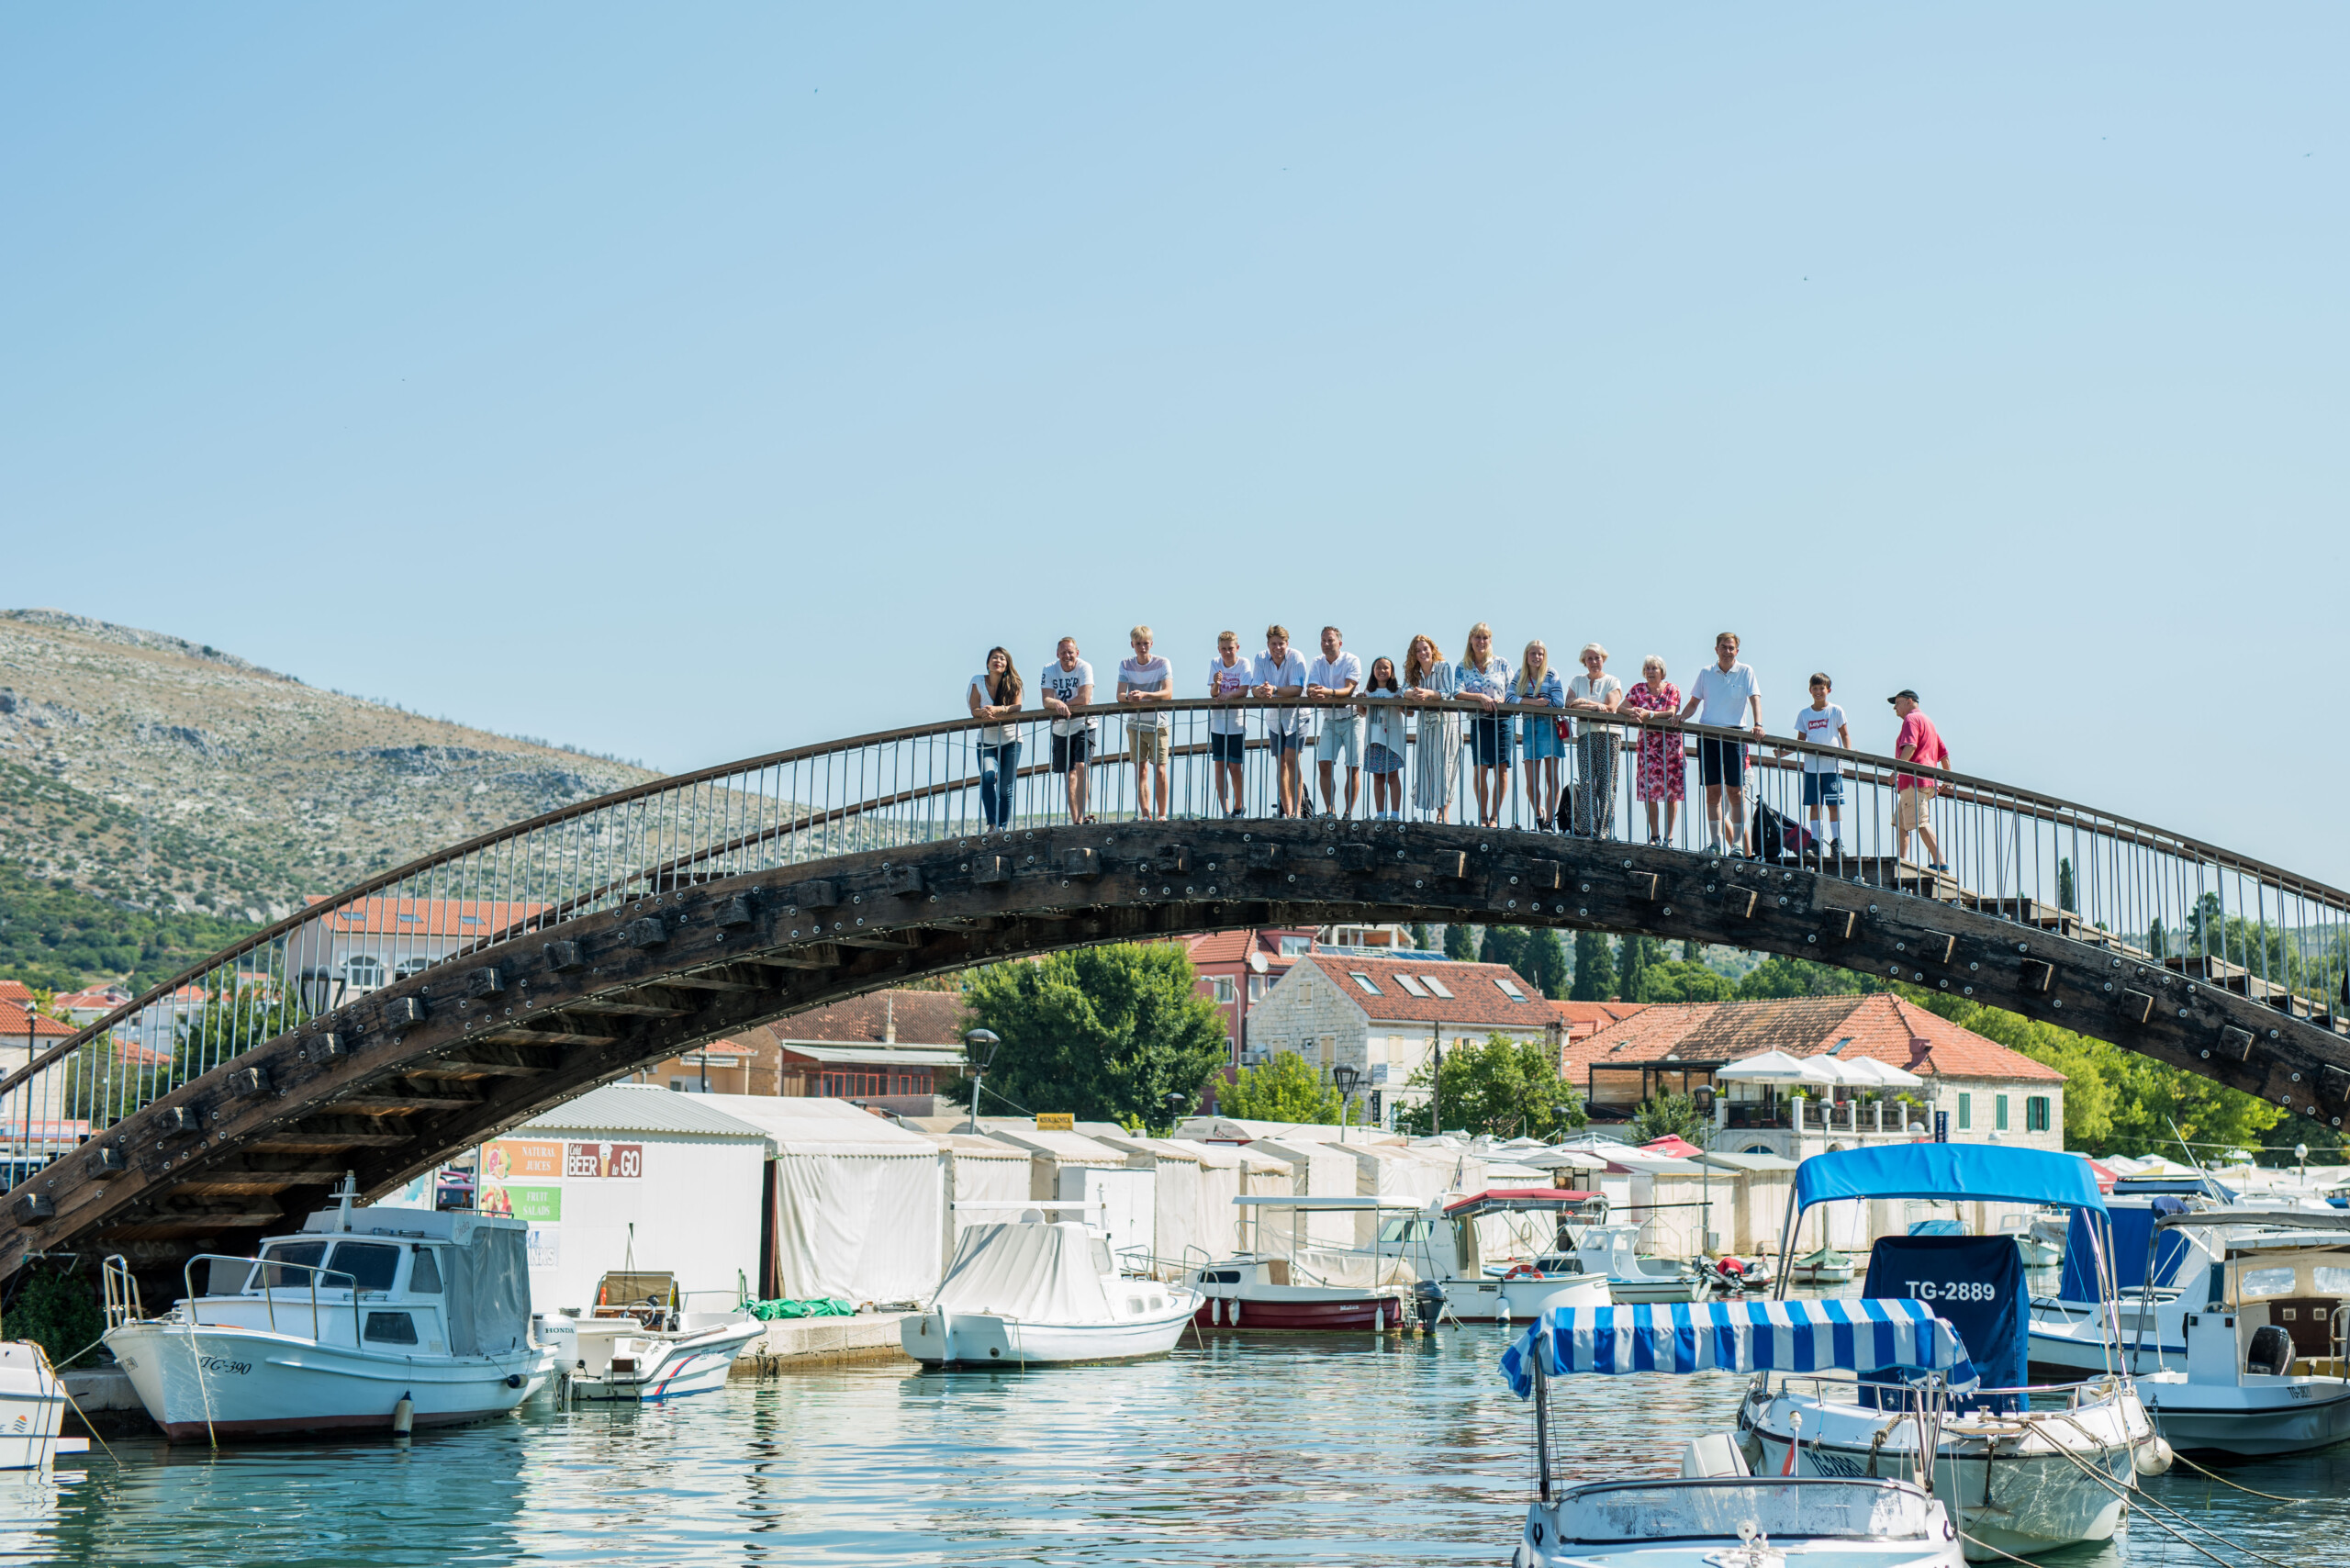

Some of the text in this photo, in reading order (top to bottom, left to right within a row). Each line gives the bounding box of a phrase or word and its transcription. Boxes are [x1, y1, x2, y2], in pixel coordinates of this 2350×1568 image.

[521, 1146, 555, 1158] NATURAL
[569, 1143, 583, 1156] Cold
[525, 1159, 551, 1171] JUICES
[568, 1155, 598, 1176] BEER
[621, 1150, 640, 1177] GO
[526, 1192, 548, 1202] FRUIT
[522, 1205, 550, 1216] SALADS
[528, 1248, 555, 1266] INKS
[1905, 1281, 1996, 1303] TG-2889
[200, 1356, 252, 1375] TG-390
